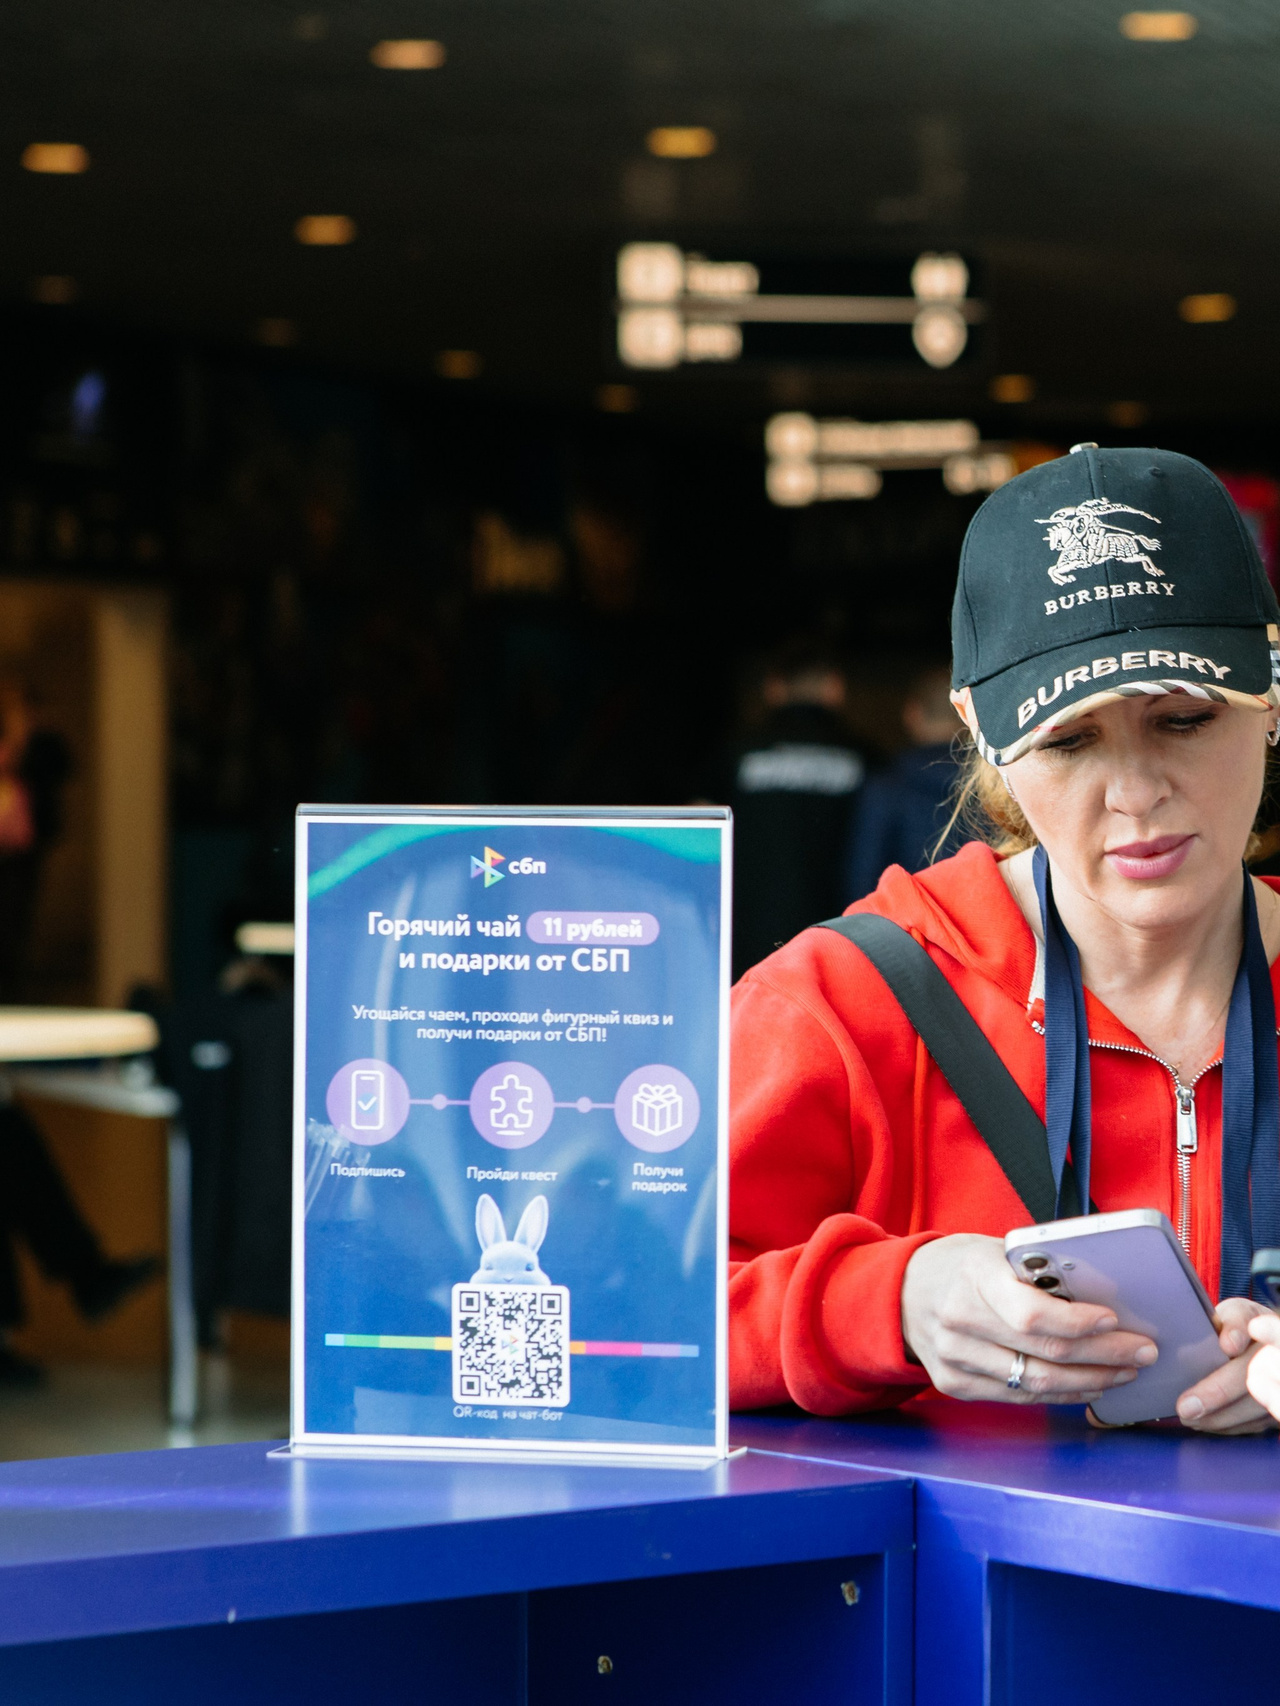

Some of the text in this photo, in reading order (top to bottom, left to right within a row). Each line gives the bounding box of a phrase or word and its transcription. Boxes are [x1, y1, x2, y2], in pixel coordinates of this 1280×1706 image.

[1044, 581, 1176, 615] BURBERRY
[1018, 649, 1232, 729] BURBERRY
[508, 858, 546, 874] сбп
[368, 912, 642, 941] Горячий чай 11 рублей
[400, 948, 630, 975] и подарки от СБП
[352, 1005, 673, 1027] Угощайся чаем, проходи фигурный квиз и
[417, 1027, 606, 1043] получи подарки от СБП!
[331, 1164, 406, 1178] Подпишись
[467, 1167, 557, 1182] Пройди квест
[633, 1162, 684, 1178] Получи
[632, 1181, 687, 1194] подарок
[503, 1409, 517, 1420] на
[519, 1409, 563, 1421] чат-бот
